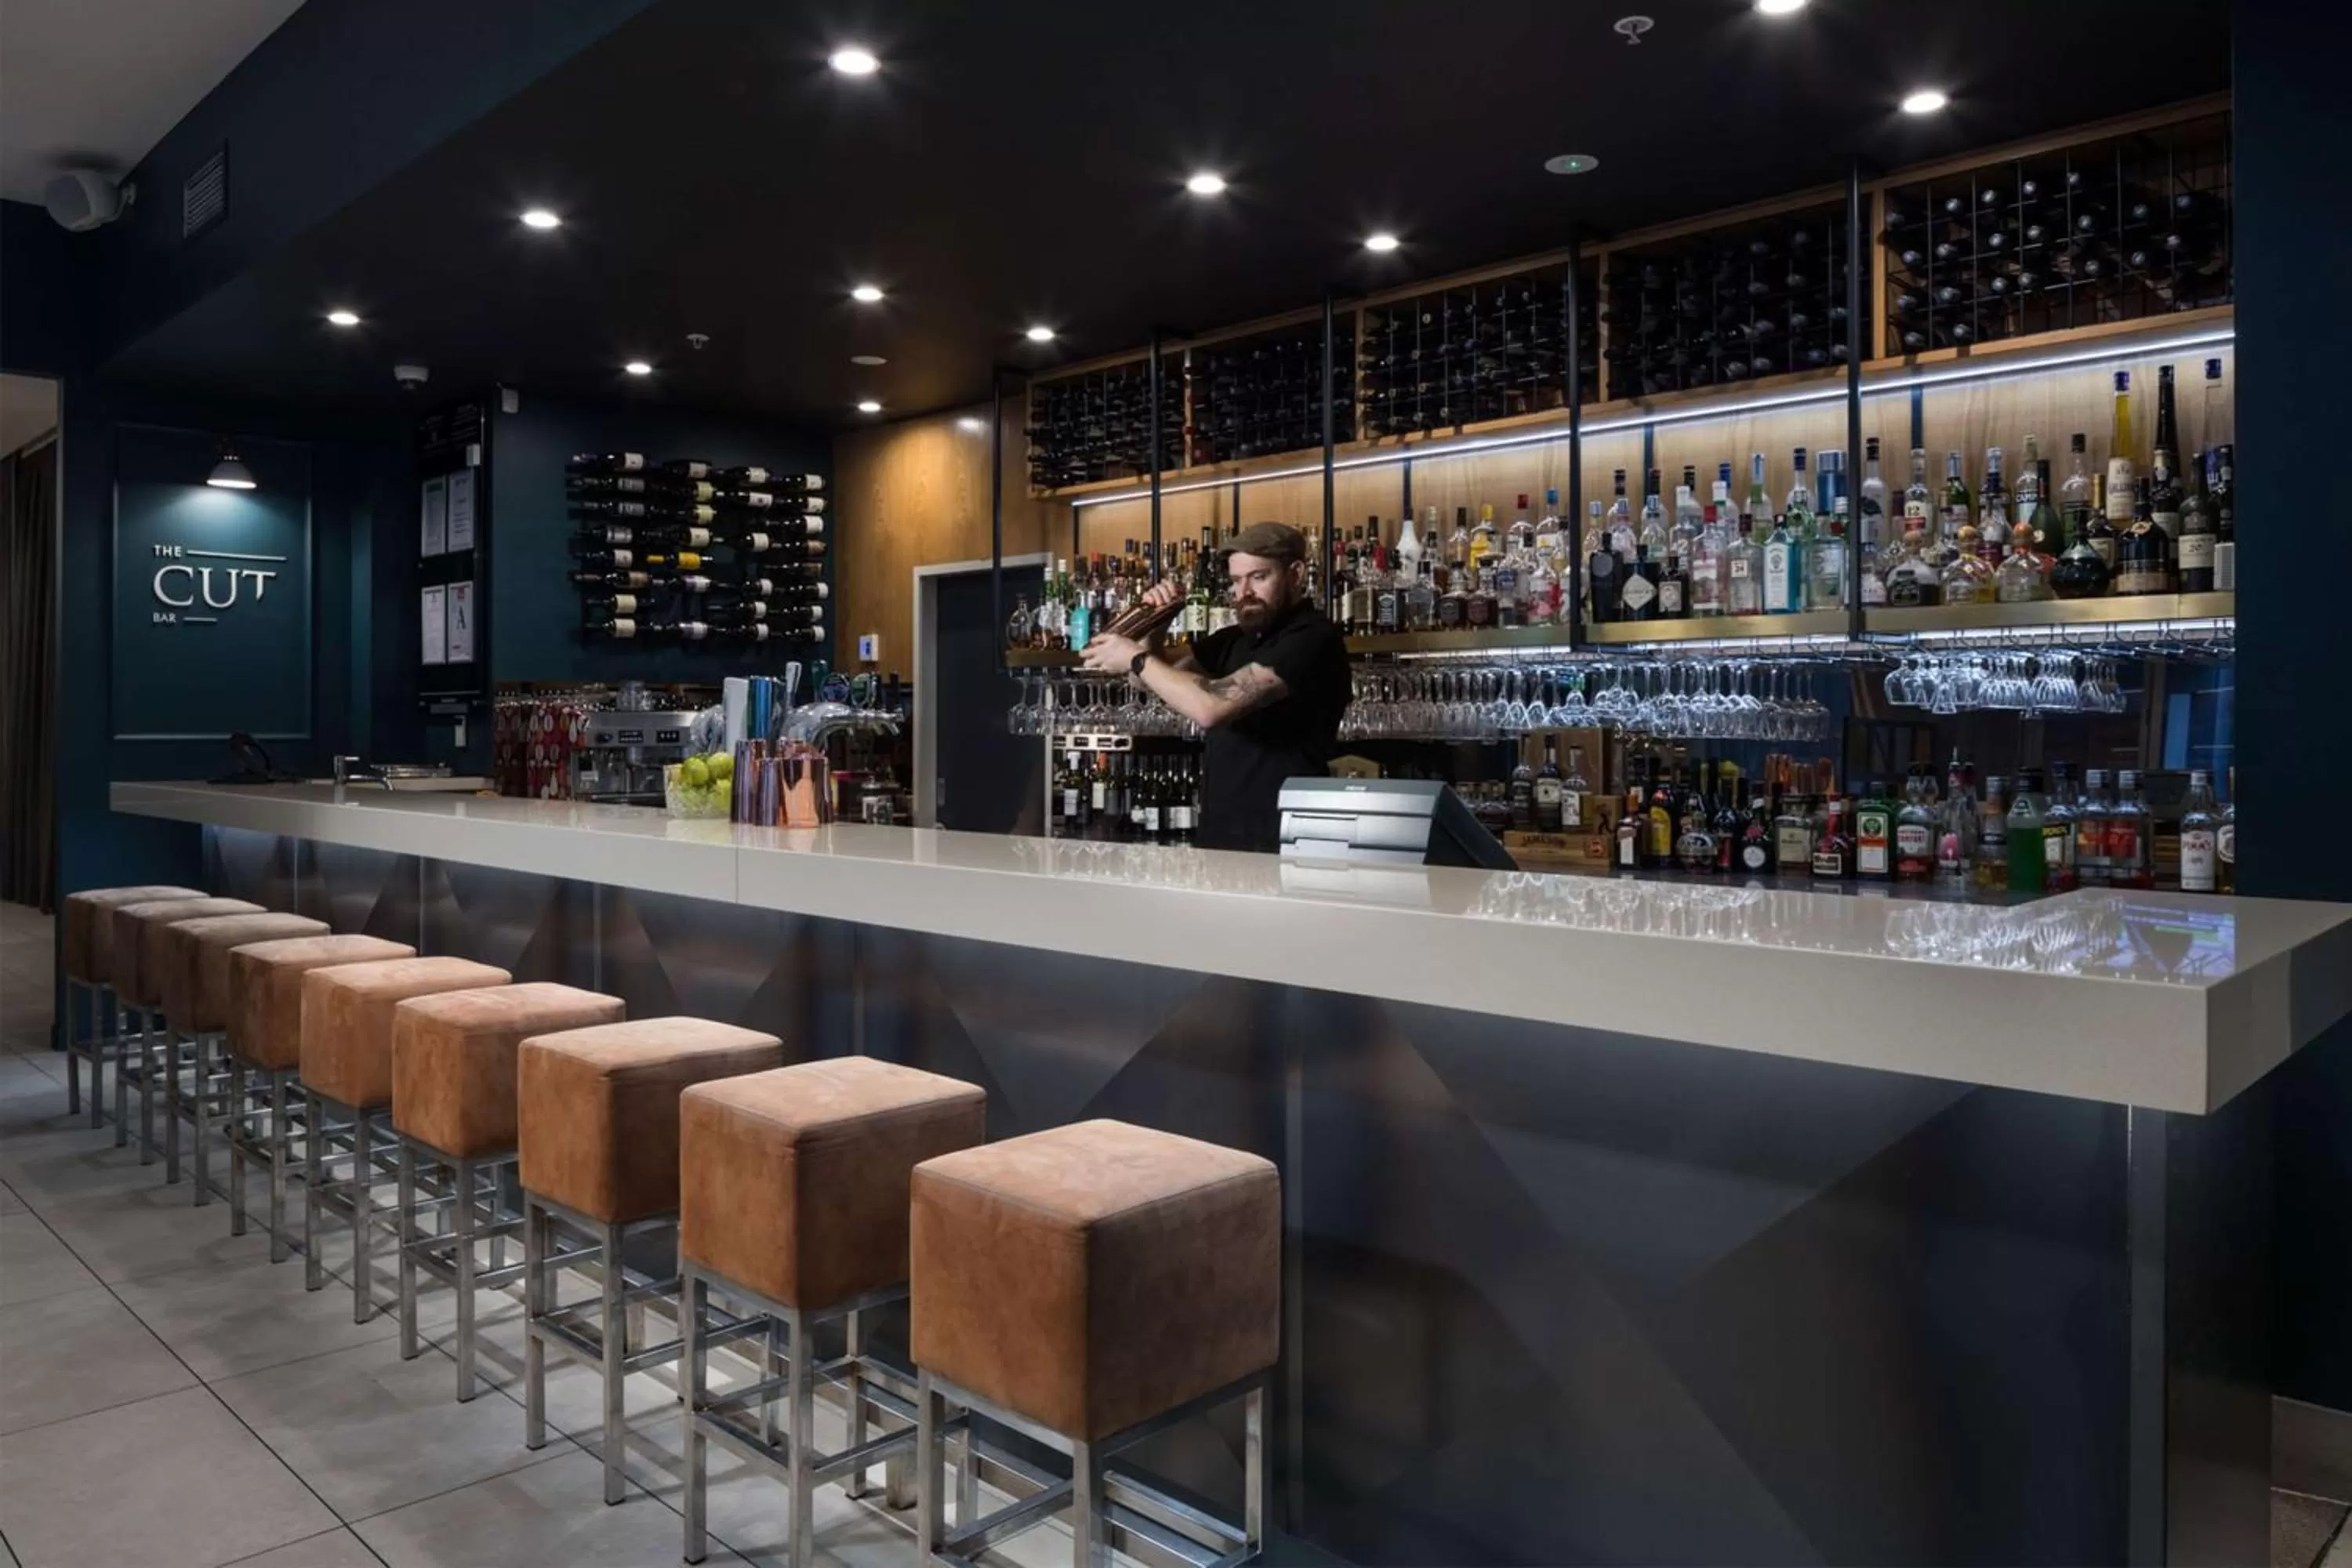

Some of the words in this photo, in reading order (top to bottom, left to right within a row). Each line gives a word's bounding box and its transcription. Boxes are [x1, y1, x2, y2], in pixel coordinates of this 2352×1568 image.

[153, 545, 182, 557] THE
[153, 564, 277, 608] CUT
[153, 612, 176, 623] BAR
